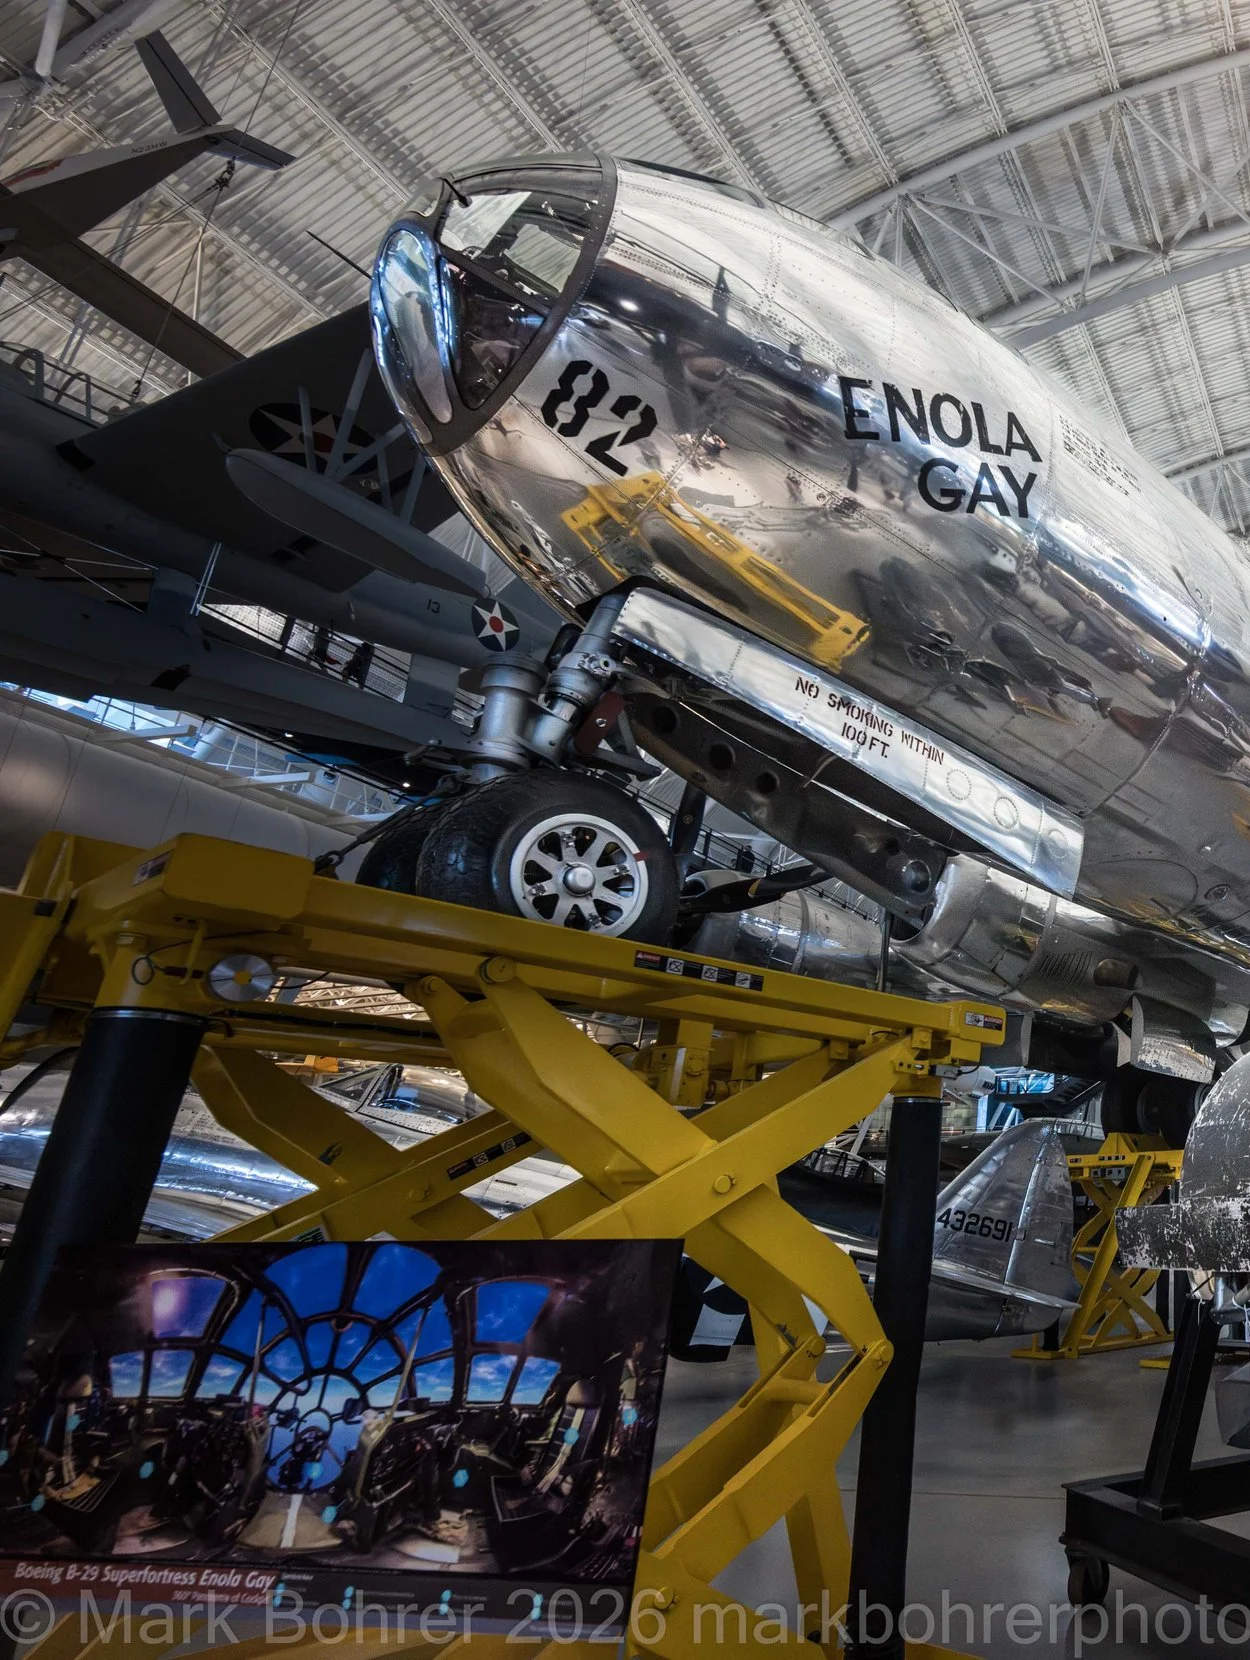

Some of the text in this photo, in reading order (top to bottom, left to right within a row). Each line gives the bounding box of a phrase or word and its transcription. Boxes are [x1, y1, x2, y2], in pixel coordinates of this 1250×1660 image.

[541, 360, 658, 477] 82
[837, 375, 1043, 463] ENOLA
[918, 457, 1038, 519] GAY
[426, 598, 441, 614] 13
[795, 676, 945, 766] NO SMOKING WITHIN
[841, 722, 891, 759] 100 FT.
[936, 1207, 1014, 1243] 432691
[14, 1561, 277, 1594] Boeing B-29 Superfortress Enola Gay
